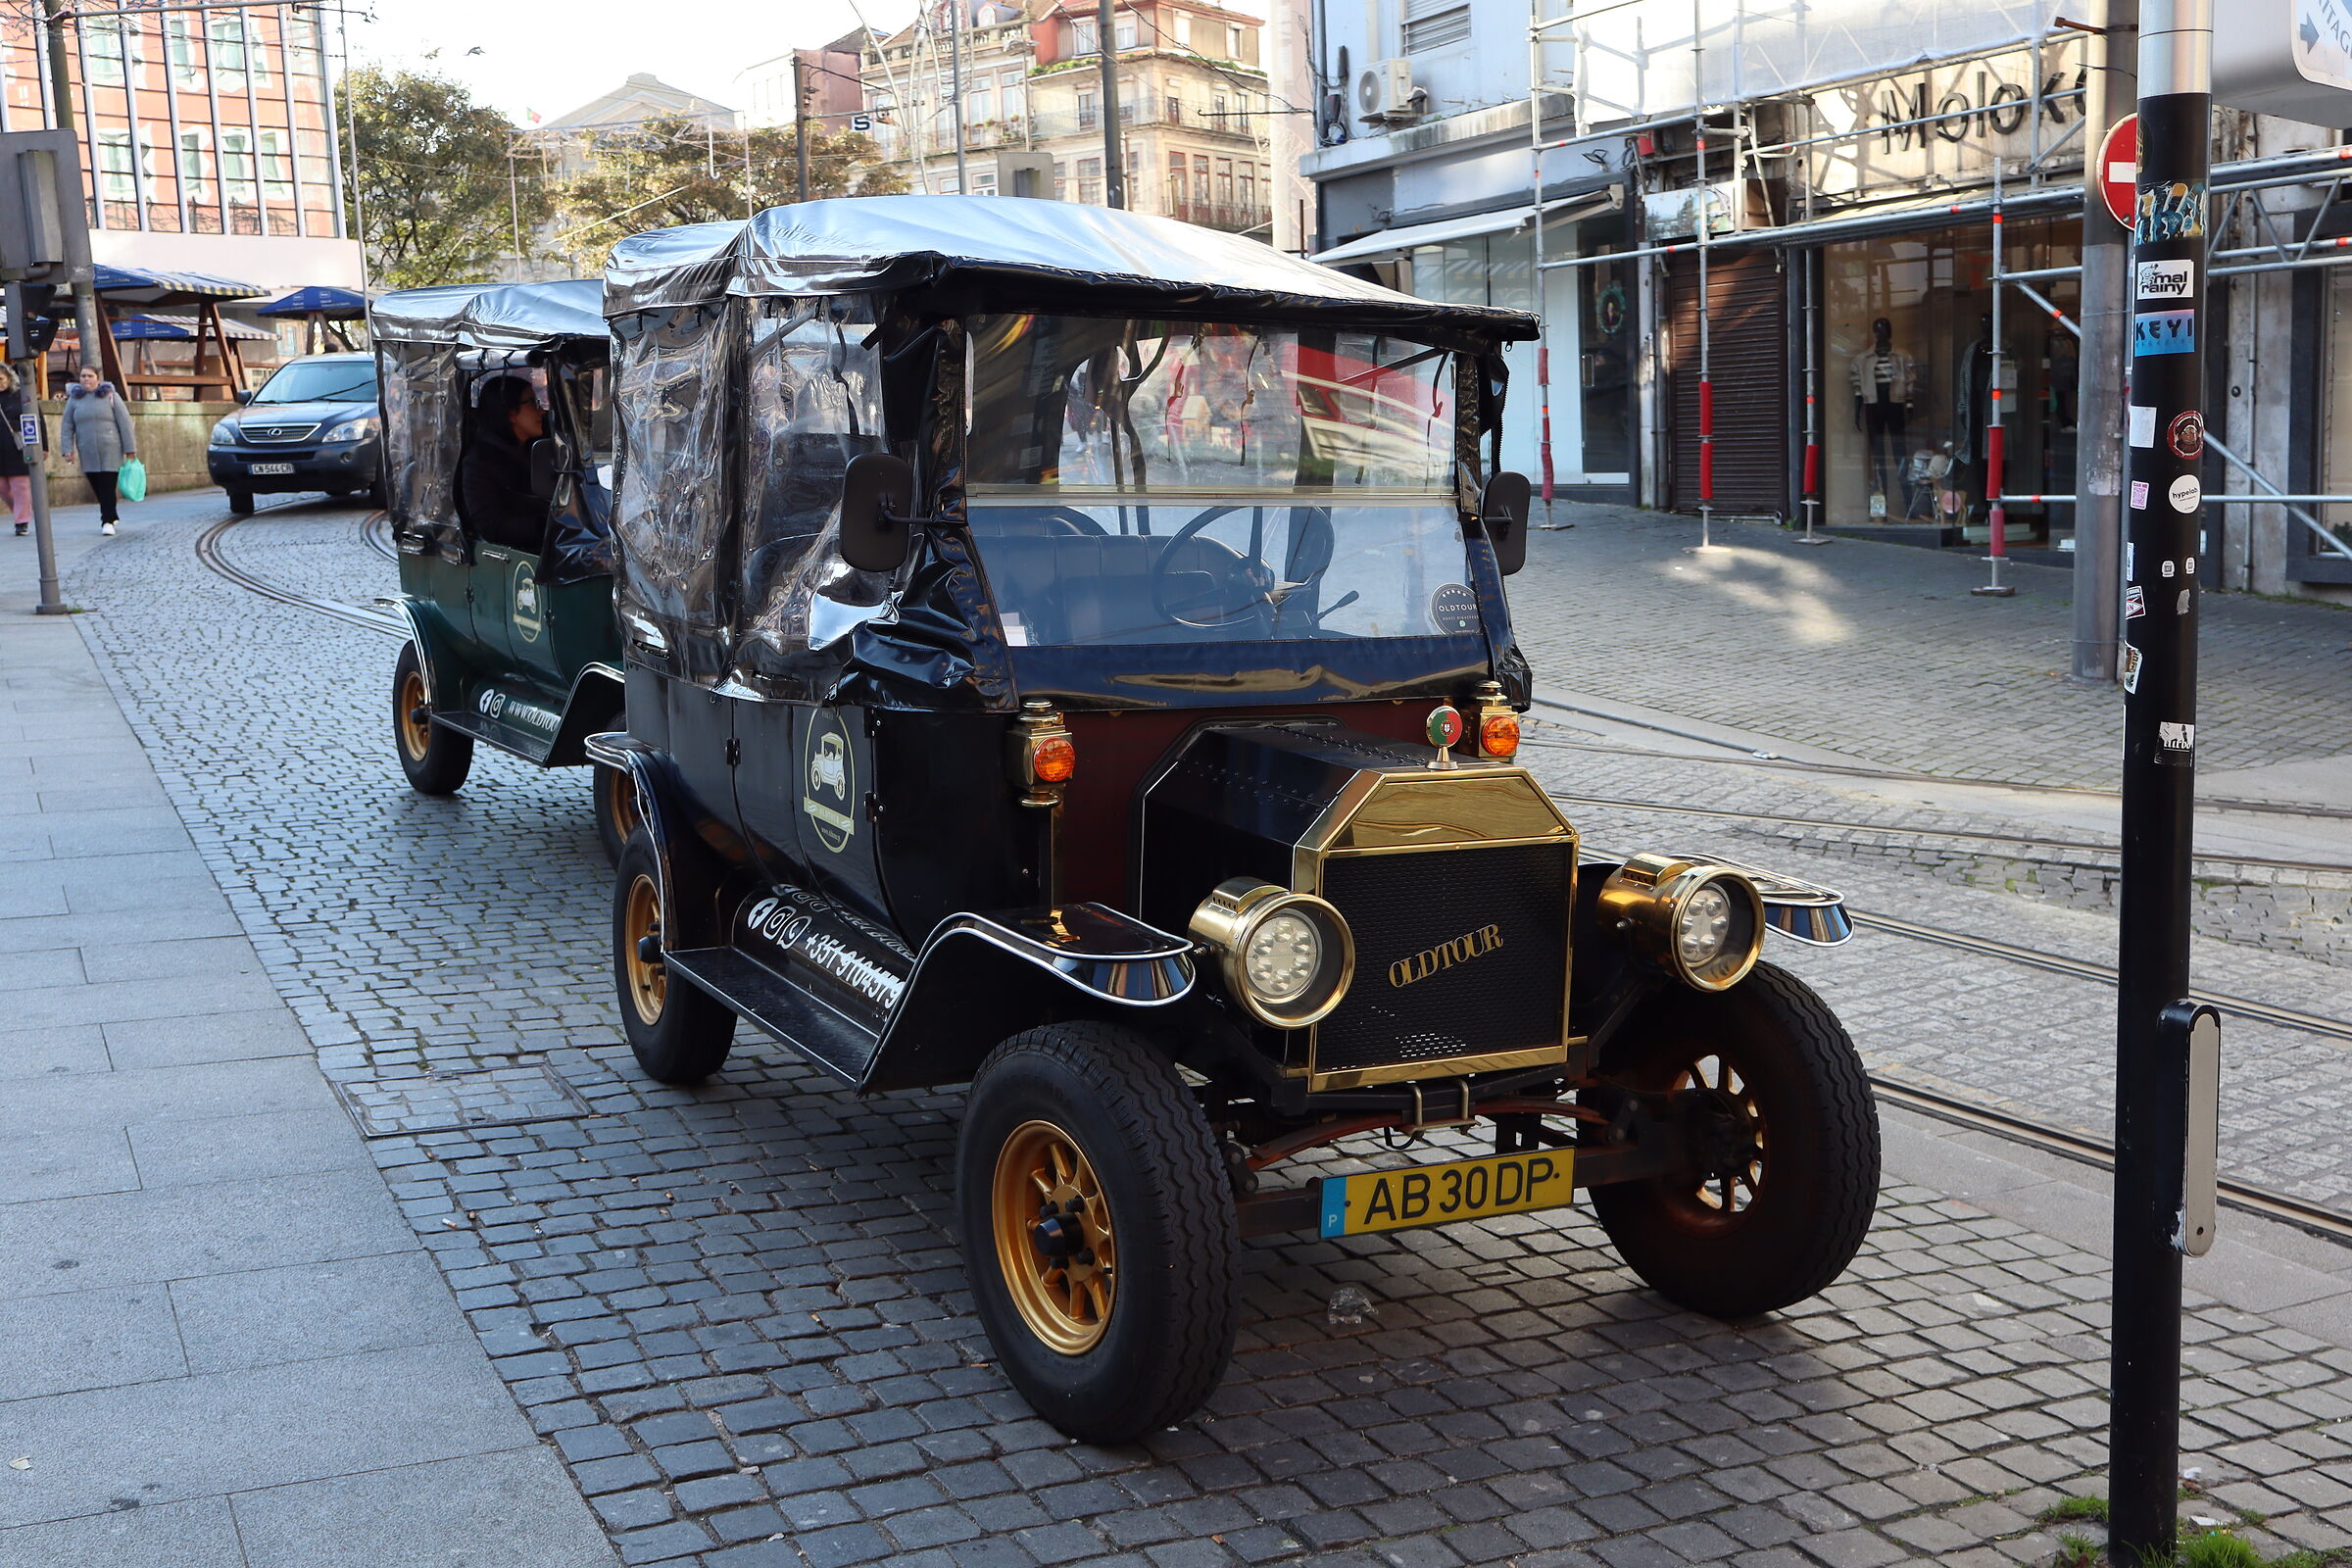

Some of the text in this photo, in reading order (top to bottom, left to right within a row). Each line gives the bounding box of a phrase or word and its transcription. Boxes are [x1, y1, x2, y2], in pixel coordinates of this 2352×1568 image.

[2319, 0, 2352, 59] ITAG
[855, 116, 870, 130] S
[2154, 270, 2187, 283] mal
[2141, 283, 2187, 295] rainy
[1389, 924, 1504, 988] OLDTOUR
[1328, 1214, 1338, 1228] P
